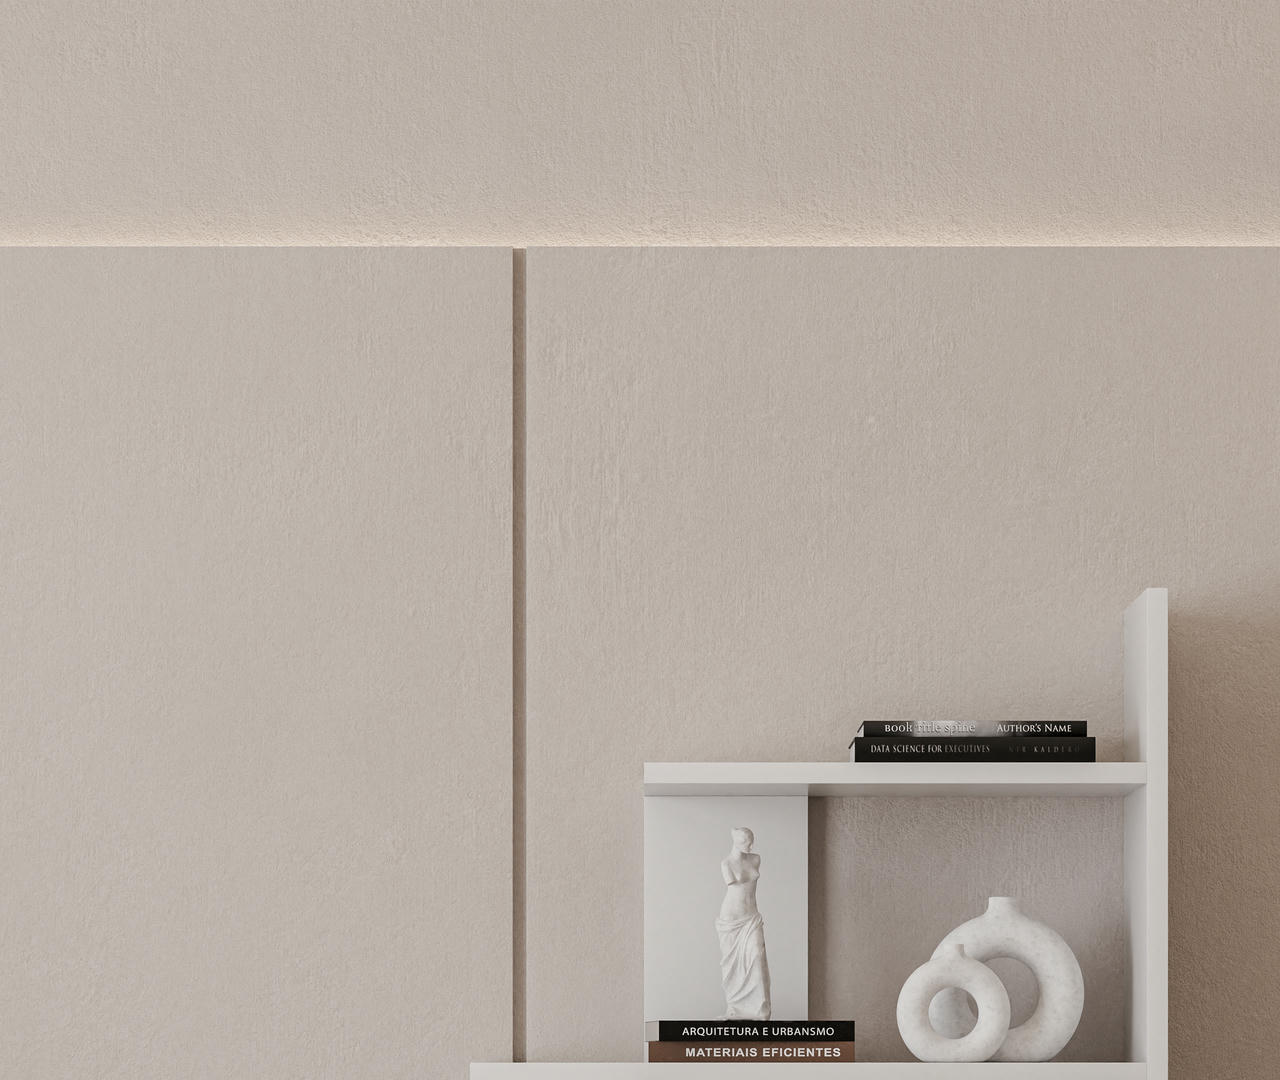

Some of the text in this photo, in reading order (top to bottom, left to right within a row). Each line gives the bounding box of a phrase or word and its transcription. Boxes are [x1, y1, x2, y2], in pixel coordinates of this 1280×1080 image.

[944, 721, 976, 735] spine
[997, 723, 1041, 733] AUTHOR'S
[1044, 723, 1072, 733] NAME
[870, 744, 990, 753] DATA SCIENCE FOR EXECUTIVES
[682, 1027, 835, 1037] ARQUITETURA E URBANSMO
[685, 1047, 841, 1057] MATERIAIS EFICIENTES
